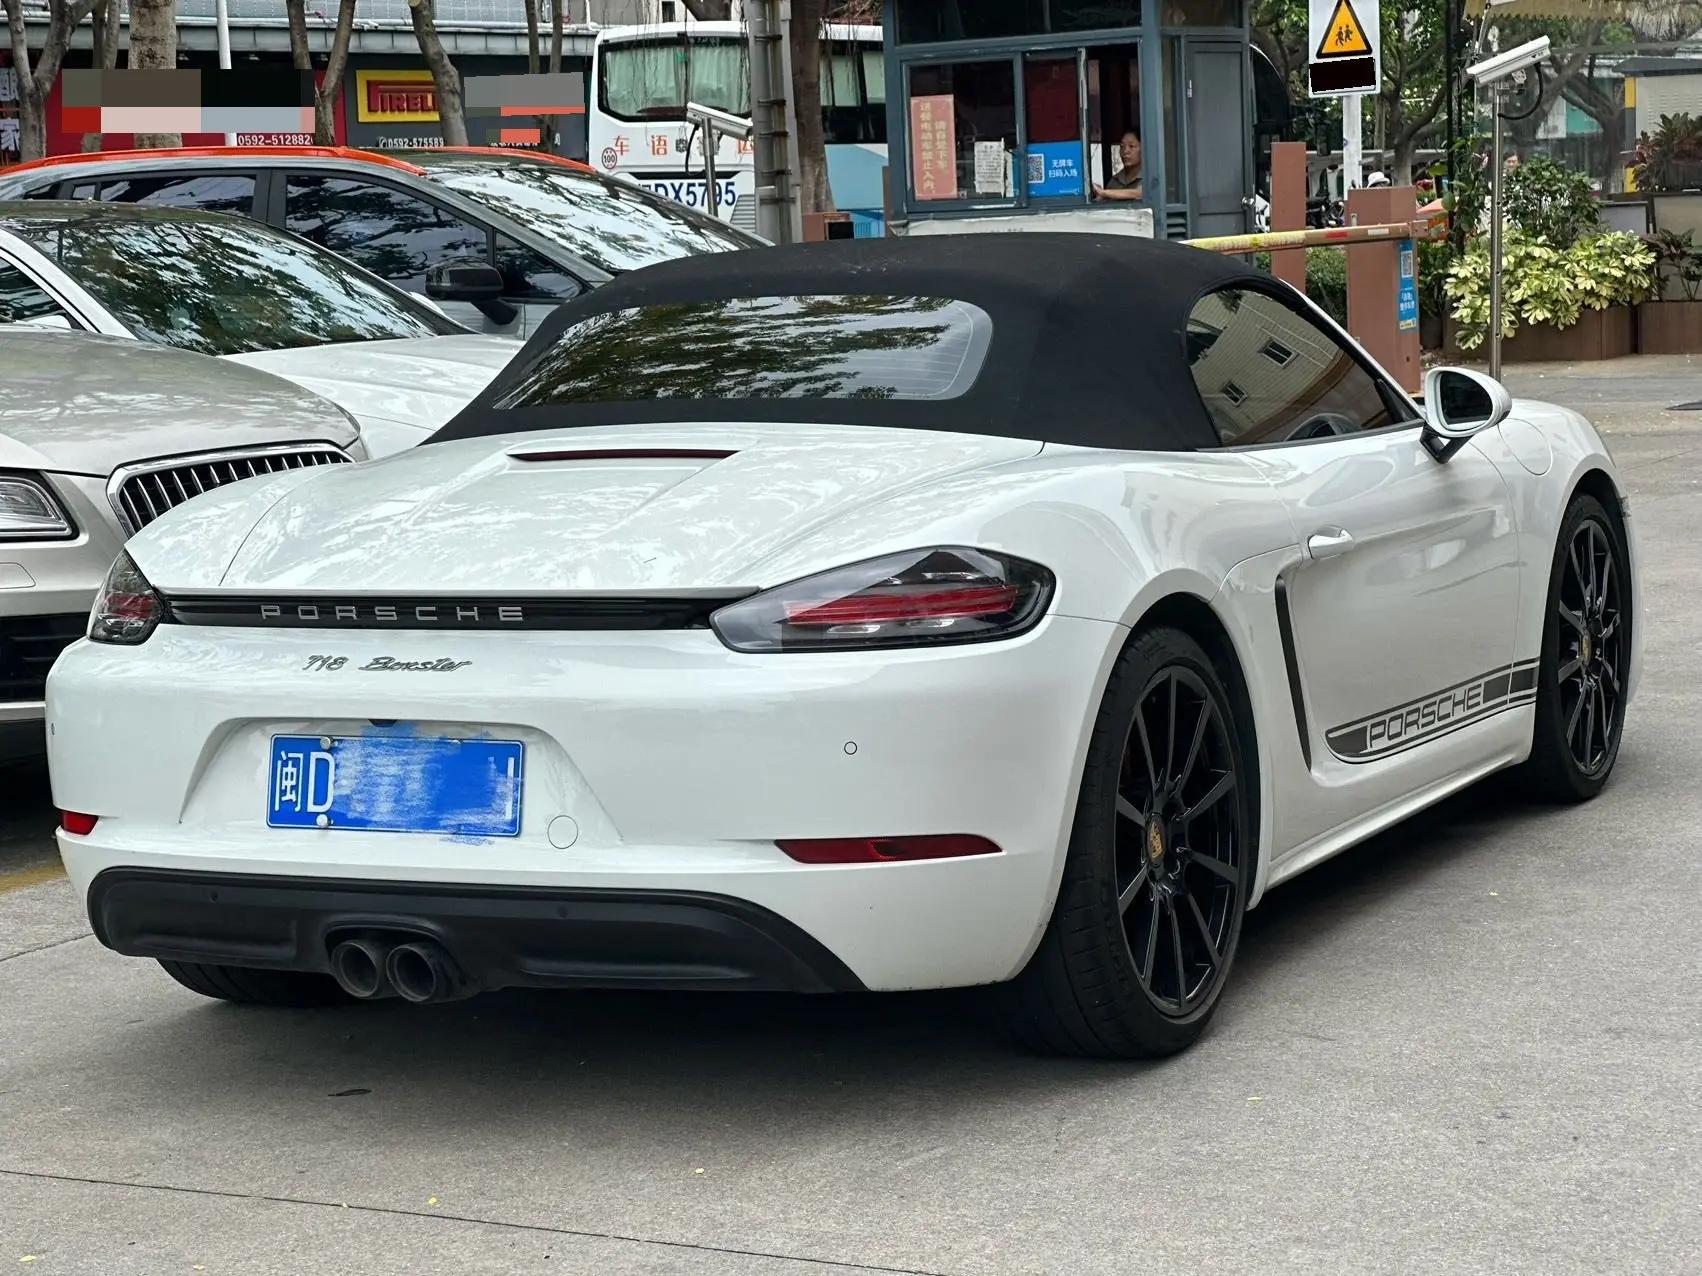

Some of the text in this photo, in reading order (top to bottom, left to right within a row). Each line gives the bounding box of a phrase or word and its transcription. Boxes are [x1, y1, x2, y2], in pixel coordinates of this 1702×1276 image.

[367, 80, 439, 112] PIREL
[604, 153, 616, 163] 100
[1048, 169, 1078, 178] 扫码入场
[638, 181, 736, 208] DX5795
[260, 605, 524, 622] PORSCHE
[302, 654, 473, 673] 718 Boxster
[1368, 682, 1483, 749] PORSCHE
